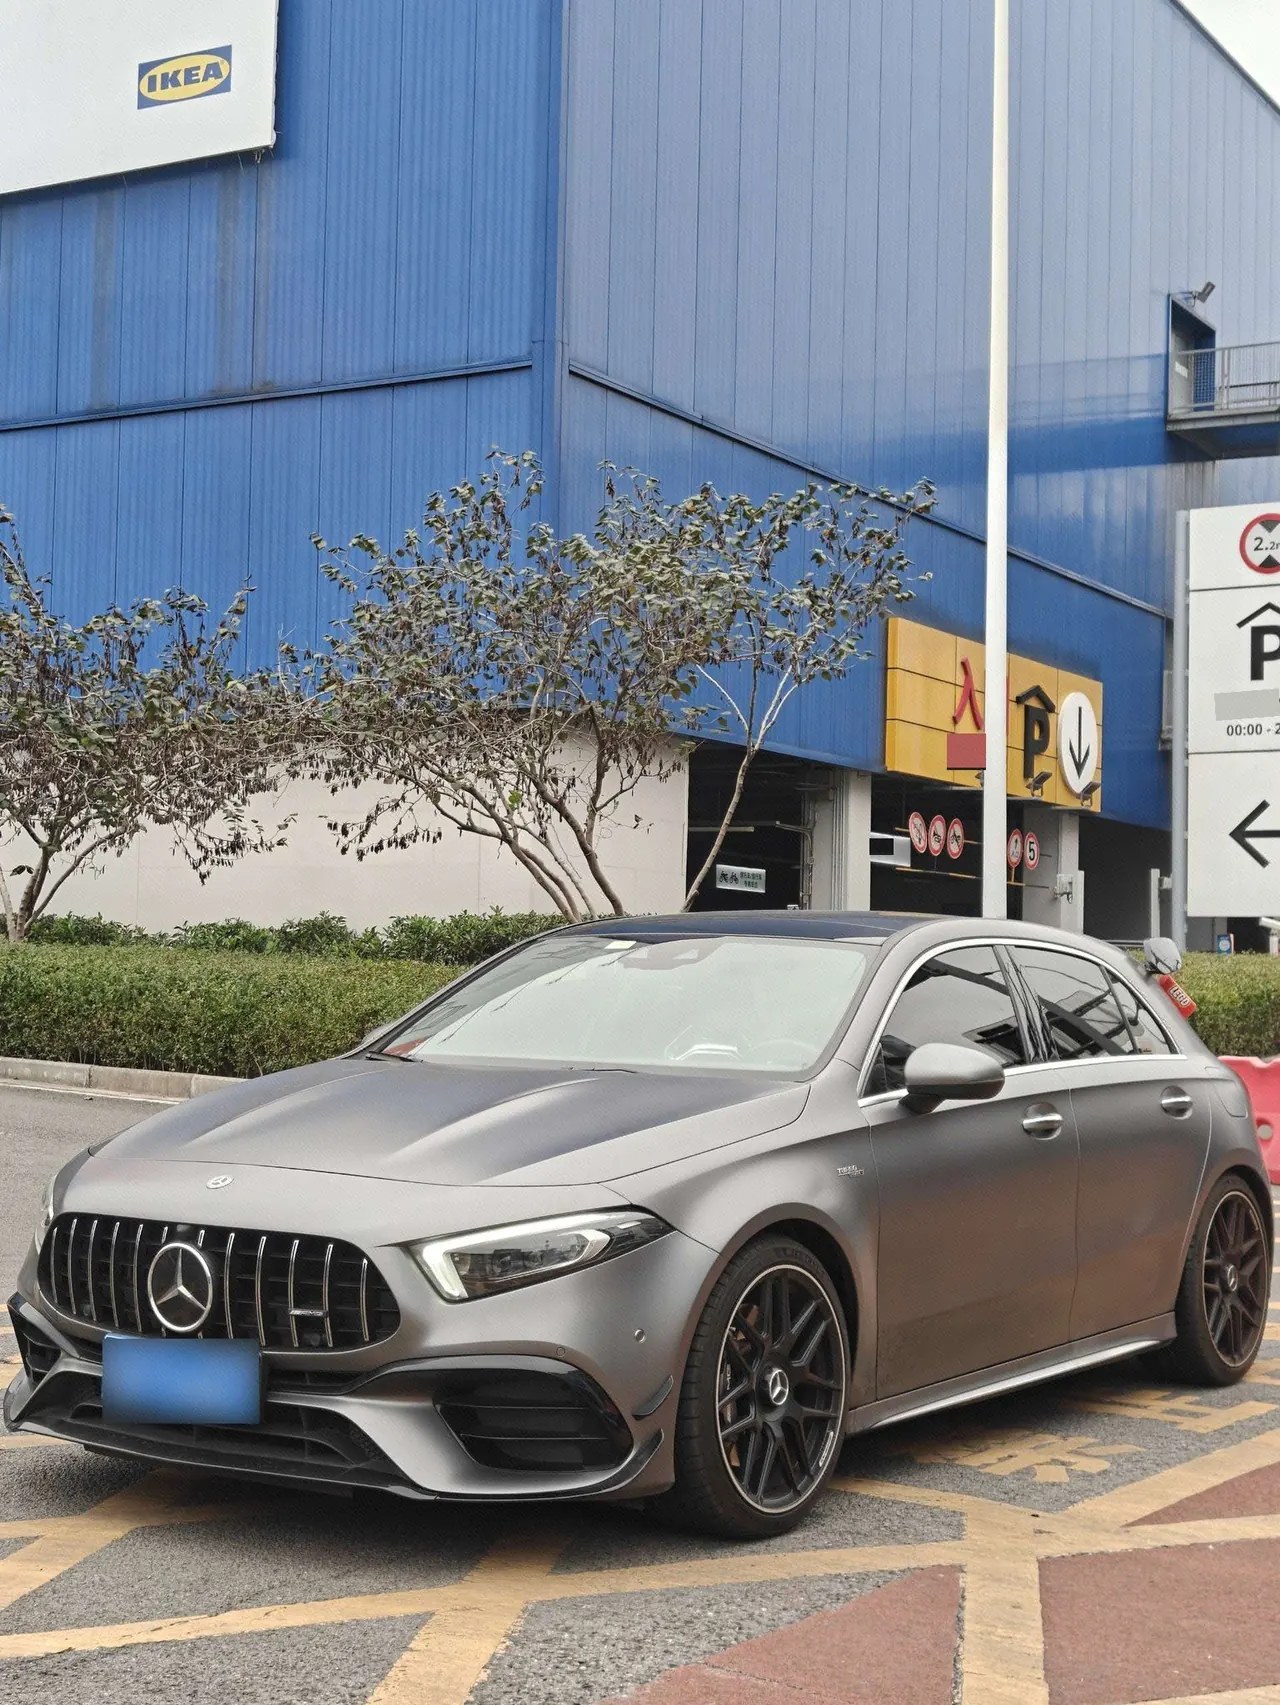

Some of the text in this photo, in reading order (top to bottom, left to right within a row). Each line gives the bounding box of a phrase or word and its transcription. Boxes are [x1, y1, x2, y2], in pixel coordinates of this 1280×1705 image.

[147, 62, 224, 93] IKEA
[1250, 625, 1280, 680] P
[1023, 704, 1050, 780] P
[1226, 723, 1263, 736] 00:00
[1028, 840, 1036, 861] 5
[1168, 985, 1190, 1006] LEGO
